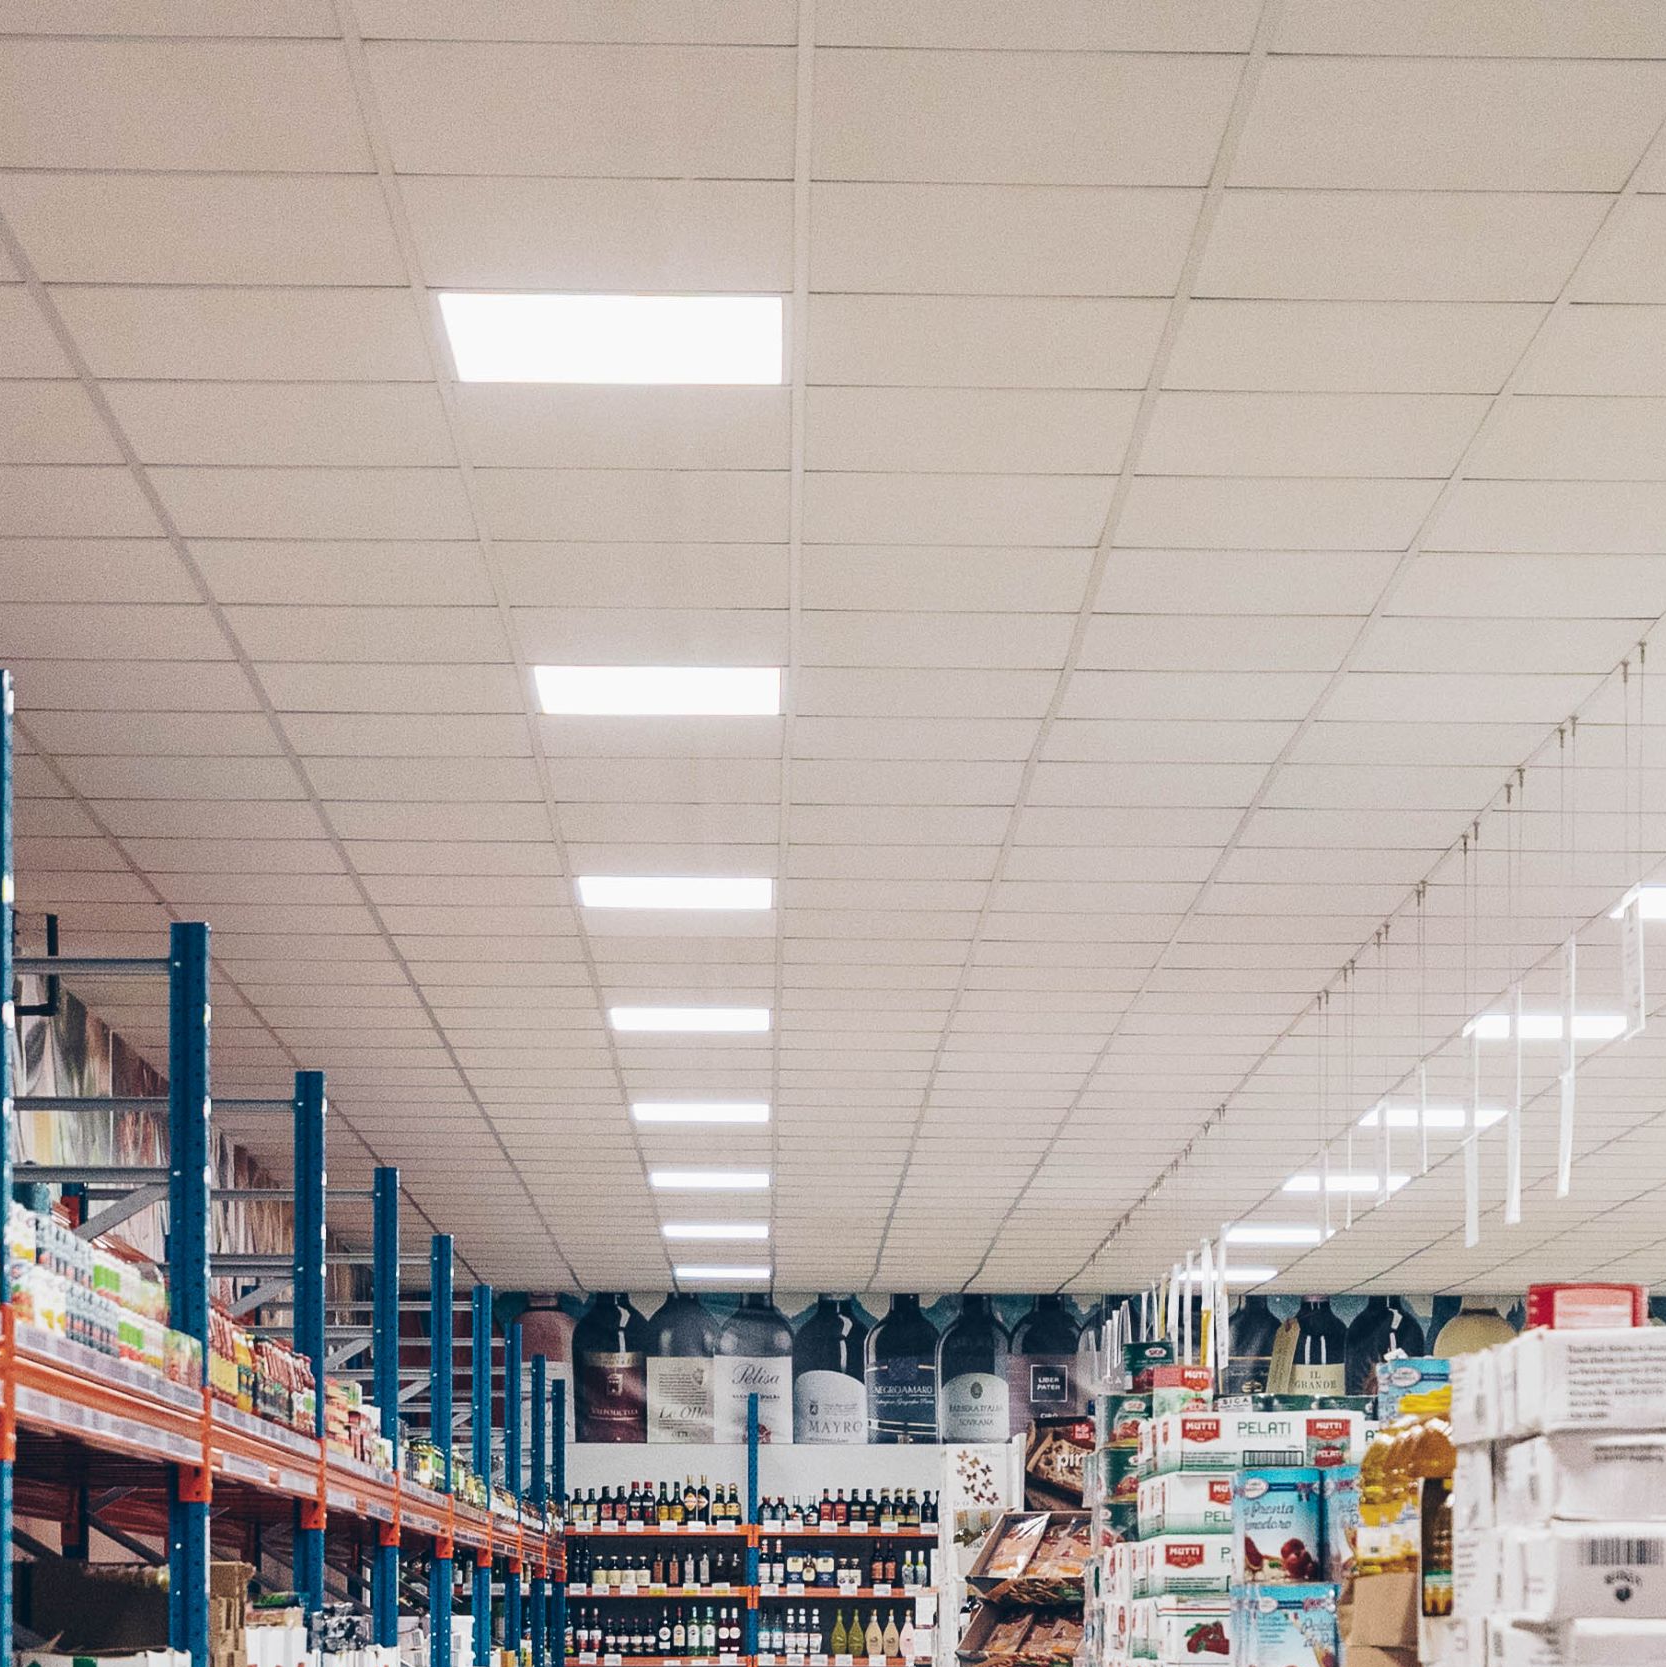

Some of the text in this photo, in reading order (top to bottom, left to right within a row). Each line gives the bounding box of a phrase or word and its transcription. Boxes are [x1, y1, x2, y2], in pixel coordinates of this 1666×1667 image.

[1294, 1379, 1337, 1390] GRANDE
[809, 1420, 863, 1434] MAYRO
[1185, 1420, 1217, 1431] MUTTI
[1237, 1421, 1292, 1436] PELATI
[1315, 1420, 1343, 1431] MUTTI
[1168, 1546, 1201, 1556] MUTTI
